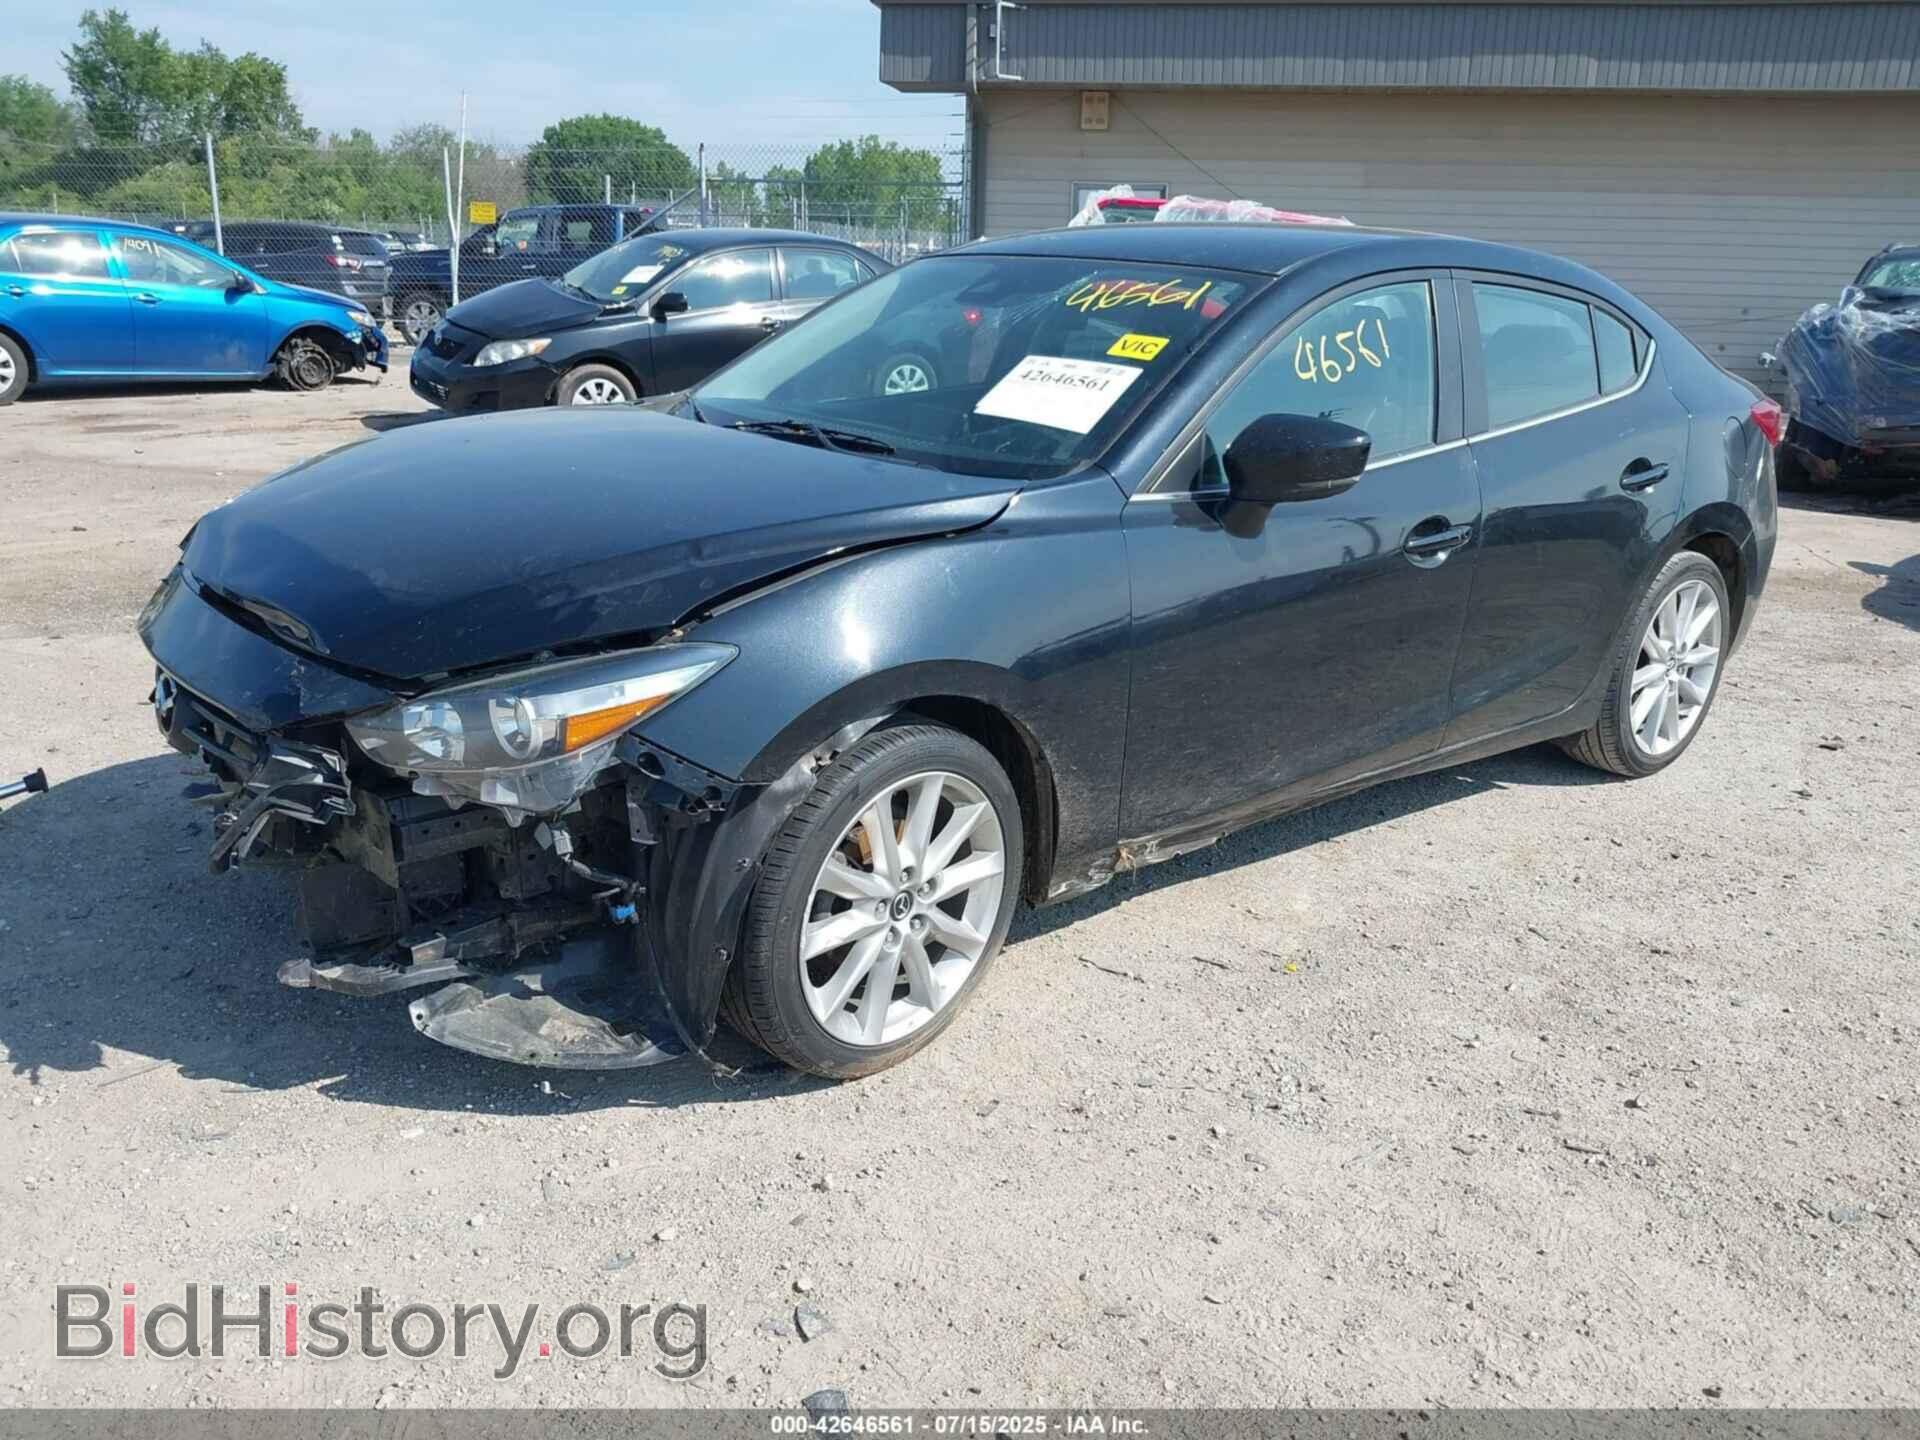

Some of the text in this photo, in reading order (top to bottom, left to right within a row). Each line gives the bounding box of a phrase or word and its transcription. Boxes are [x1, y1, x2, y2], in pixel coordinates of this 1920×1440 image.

[1065, 278, 1212, 312] 46561
[1120, 338, 1159, 355] VIC
[1294, 318, 1390, 384] 46561
[1021, 368, 1110, 392] 42646561
